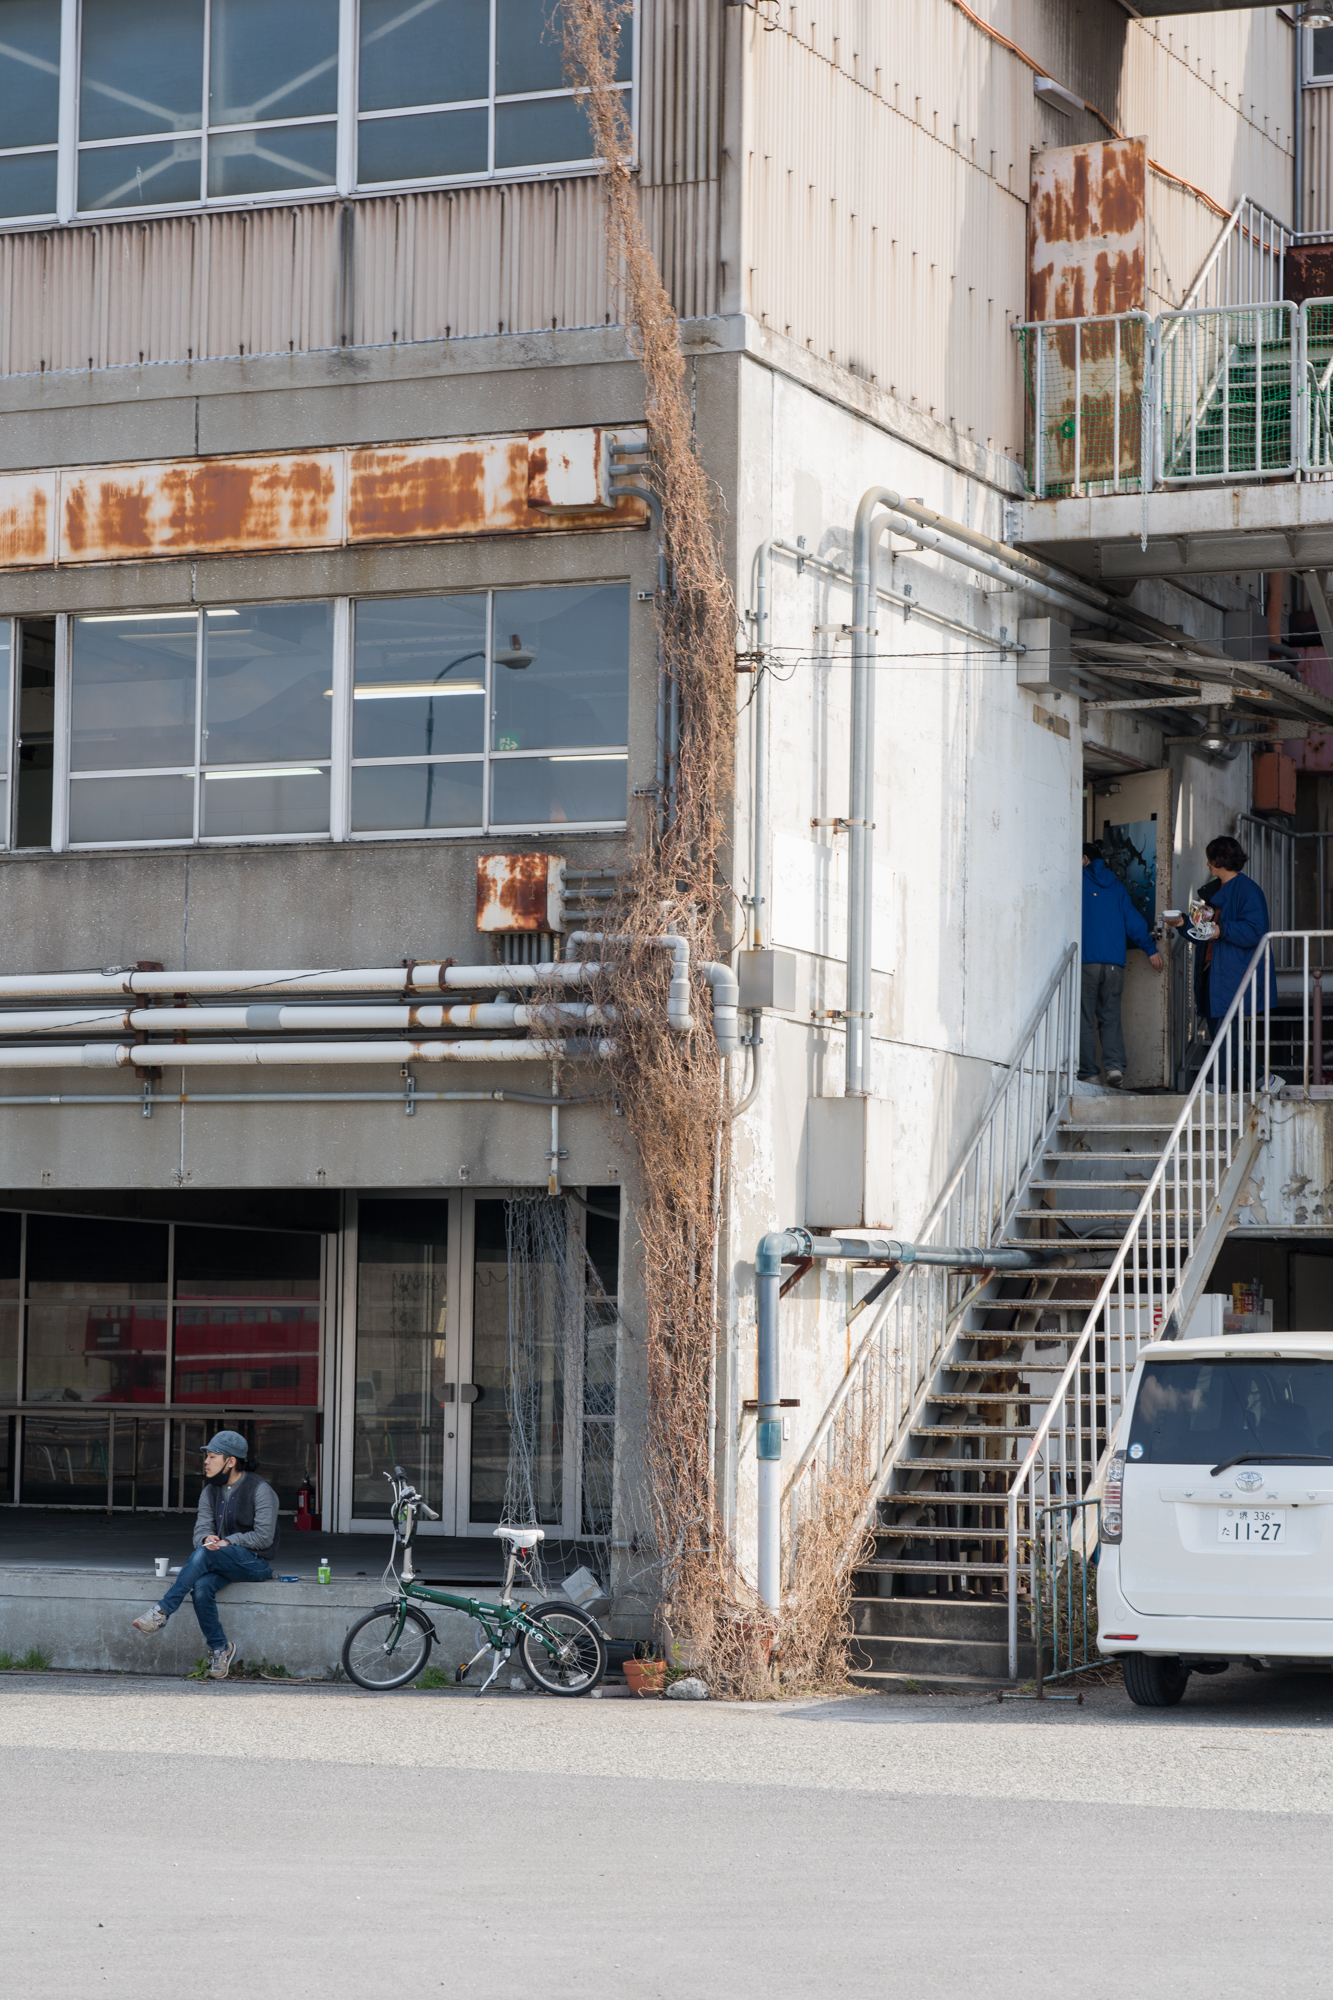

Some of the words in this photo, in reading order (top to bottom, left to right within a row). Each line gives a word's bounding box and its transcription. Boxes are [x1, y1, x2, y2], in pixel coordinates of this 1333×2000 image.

[1182, 1490, 1319, 1500] VOXY
[1239, 1511, 1248, 1520] 堺
[1254, 1511, 1271, 1521] 336
[1221, 1527, 1230, 1536] た
[1235, 1522, 1282, 1541] 11-27
[511, 1619, 544, 1643] route
